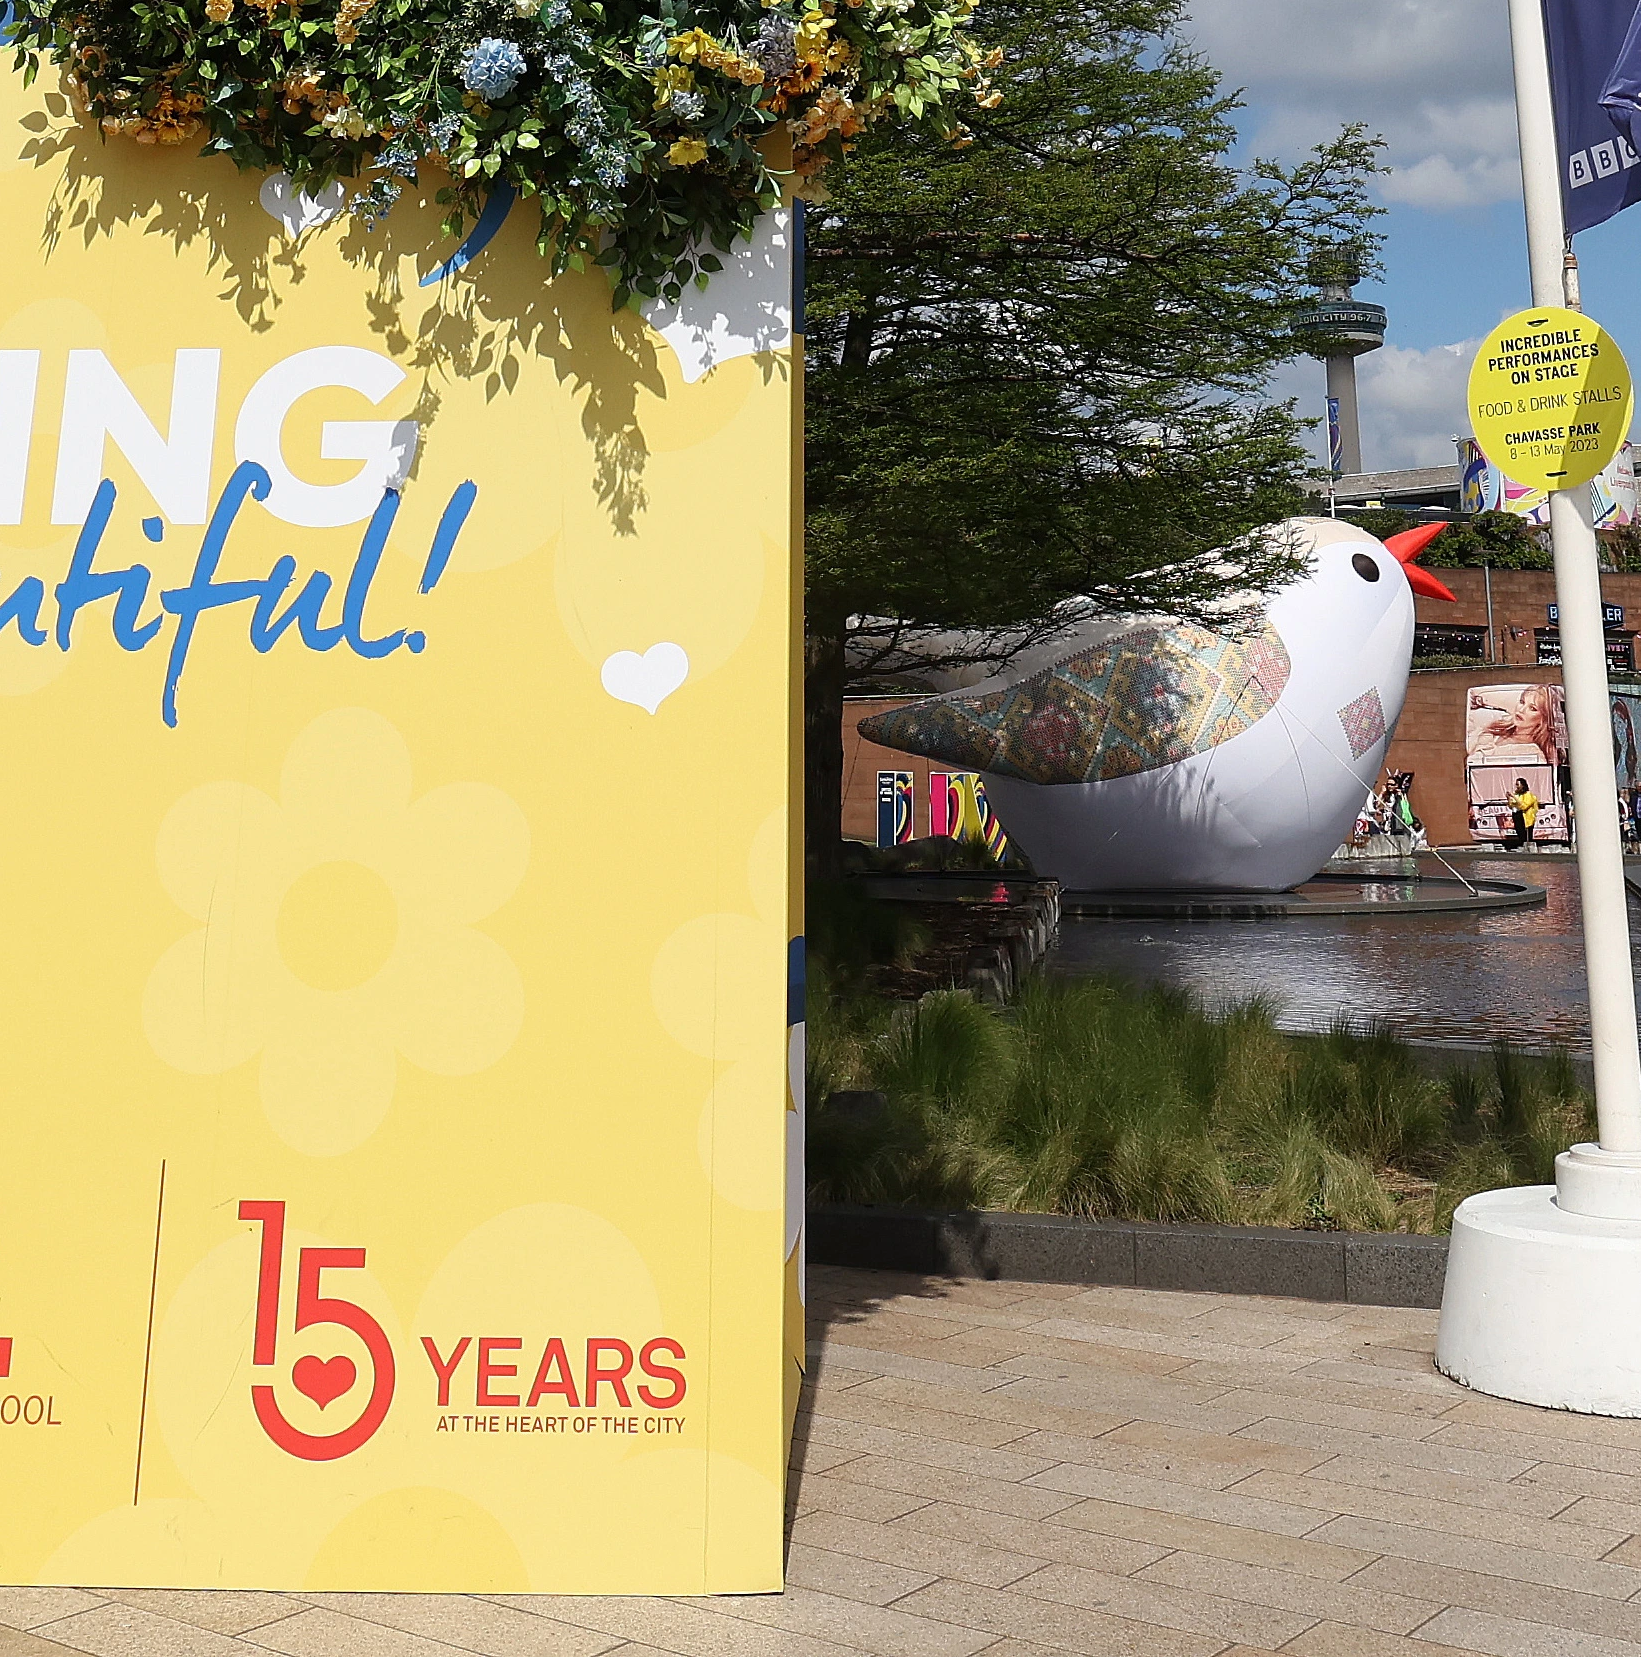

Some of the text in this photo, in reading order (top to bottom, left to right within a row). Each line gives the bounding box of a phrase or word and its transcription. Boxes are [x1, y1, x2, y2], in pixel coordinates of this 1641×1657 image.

[1297, 315, 1319, 325] ADIO
[1322, 313, 1347, 322] CITY
[1500, 329, 1581, 353] INCREDIBLE
[1488, 343, 1599, 371] PERFORMANCES
[1511, 364, 1579, 385] ON STAGE
[1478, 386, 1622, 418] FOOD & DRINK STALLS
[1505, 422, 1601, 445] CHAVASSE PARK
[1510, 447, 1517, 459] 8
[1530, 445, 1540, 457] 13
[1544, 443, 1566, 457] May
[1569, 438, 1599, 453] 2023
[237, 1199, 397, 1462] 15
[419, 1337, 688, 1409] YEARS
[436, 1415, 686, 1434] AT THE HEART OF THE CITY
